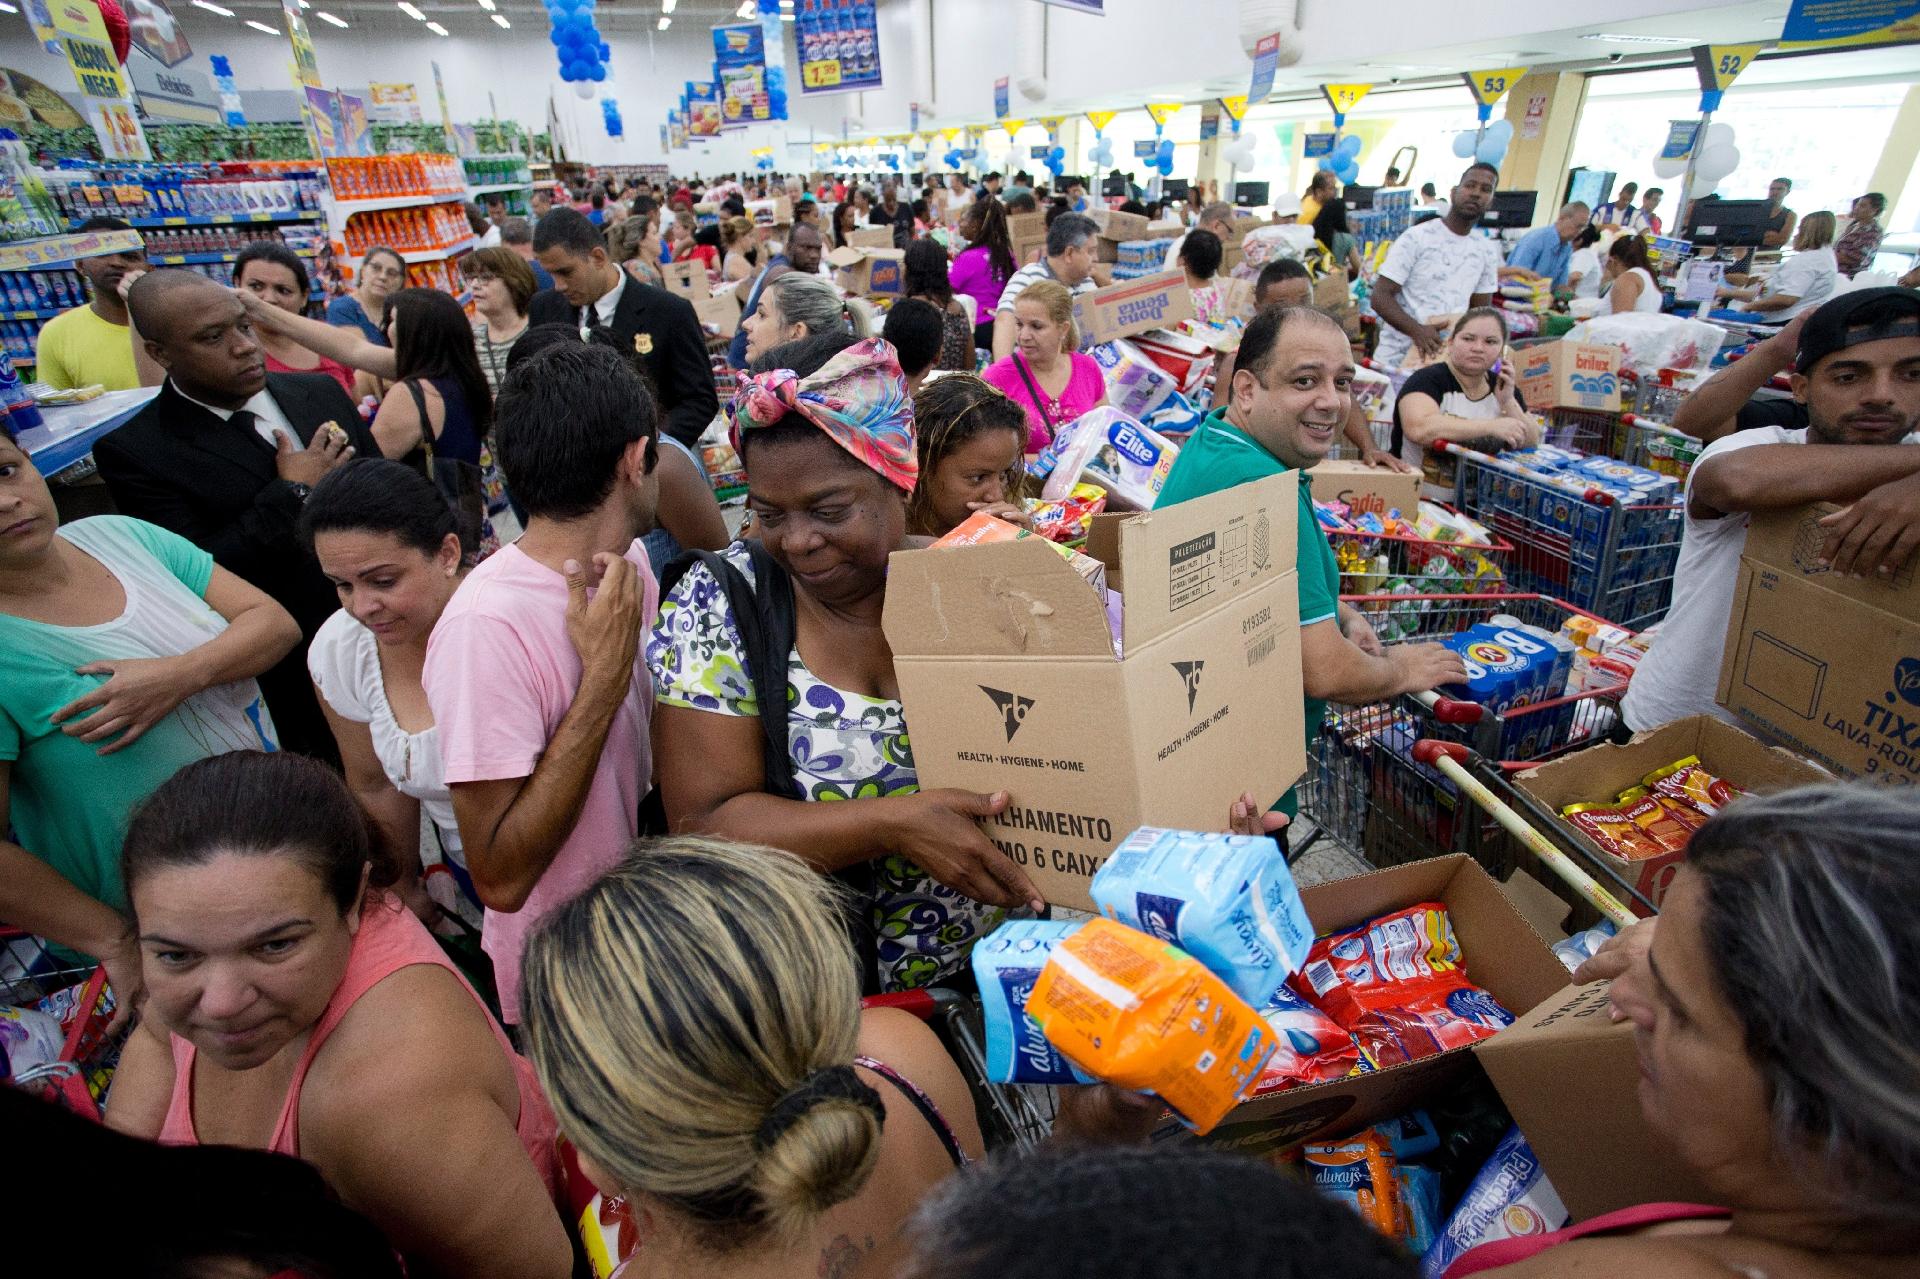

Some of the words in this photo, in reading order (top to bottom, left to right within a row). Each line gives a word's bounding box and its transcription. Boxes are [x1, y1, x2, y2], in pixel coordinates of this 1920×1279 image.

[1718, 55, 1741, 75] 52
[80, 73, 121, 98] MEGA
[156, 73, 194, 97] Bebidas
[1484, 76, 1505, 93] 53
[1117, 305, 1164, 326] Dona
[1118, 292, 1170, 316] Benta
[1114, 427, 1154, 462] Elite
[1158, 459, 1170, 474] 16
[1337, 489, 1385, 515] Sadia
[1157, 738, 1182, 762] HEALTH
[1185, 718, 1210, 743] HYGIENE
[1213, 705, 1229, 723] HOME
[957, 750, 993, 764] HEALTH
[1000, 755, 1045, 769] HYGIENE
[1051, 759, 1085, 773] HOME
[1033, 846, 1046, 868] 6
[1052, 849, 1108, 877] CAIX
[1315, 1167, 1361, 1188] always
[1361, 1190, 1368, 1199] 8
